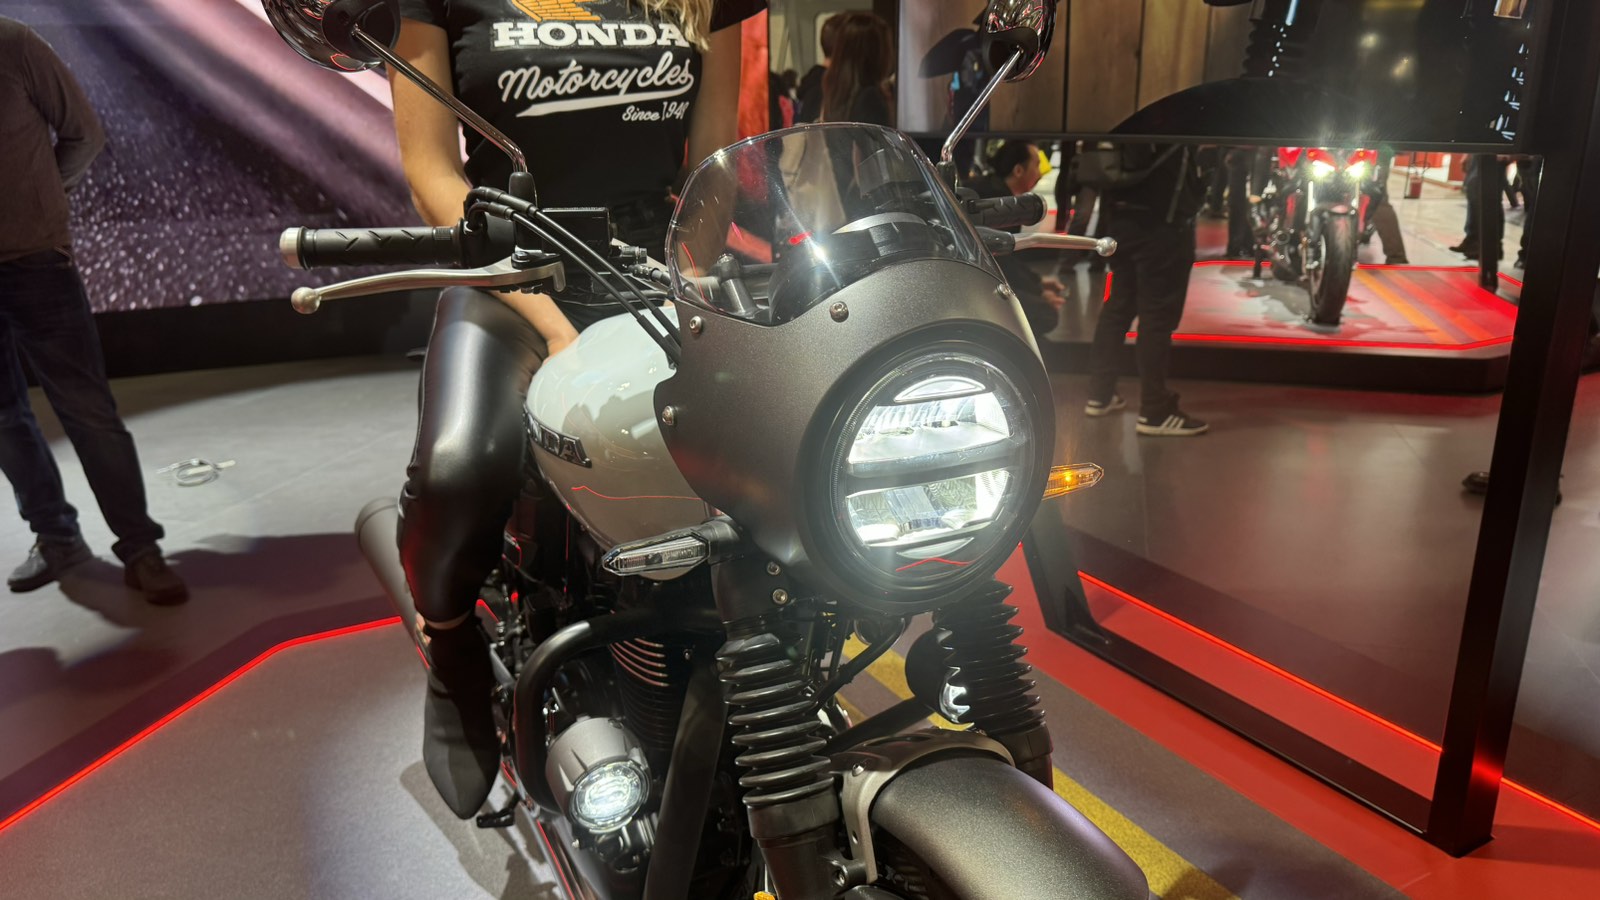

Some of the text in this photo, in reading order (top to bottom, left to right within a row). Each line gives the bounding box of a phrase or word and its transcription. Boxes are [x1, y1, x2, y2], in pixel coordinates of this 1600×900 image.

[493, 22, 690, 47] HONDA
[498, 51, 694, 102] Motorcycles
[622, 105, 661, 121] Since
